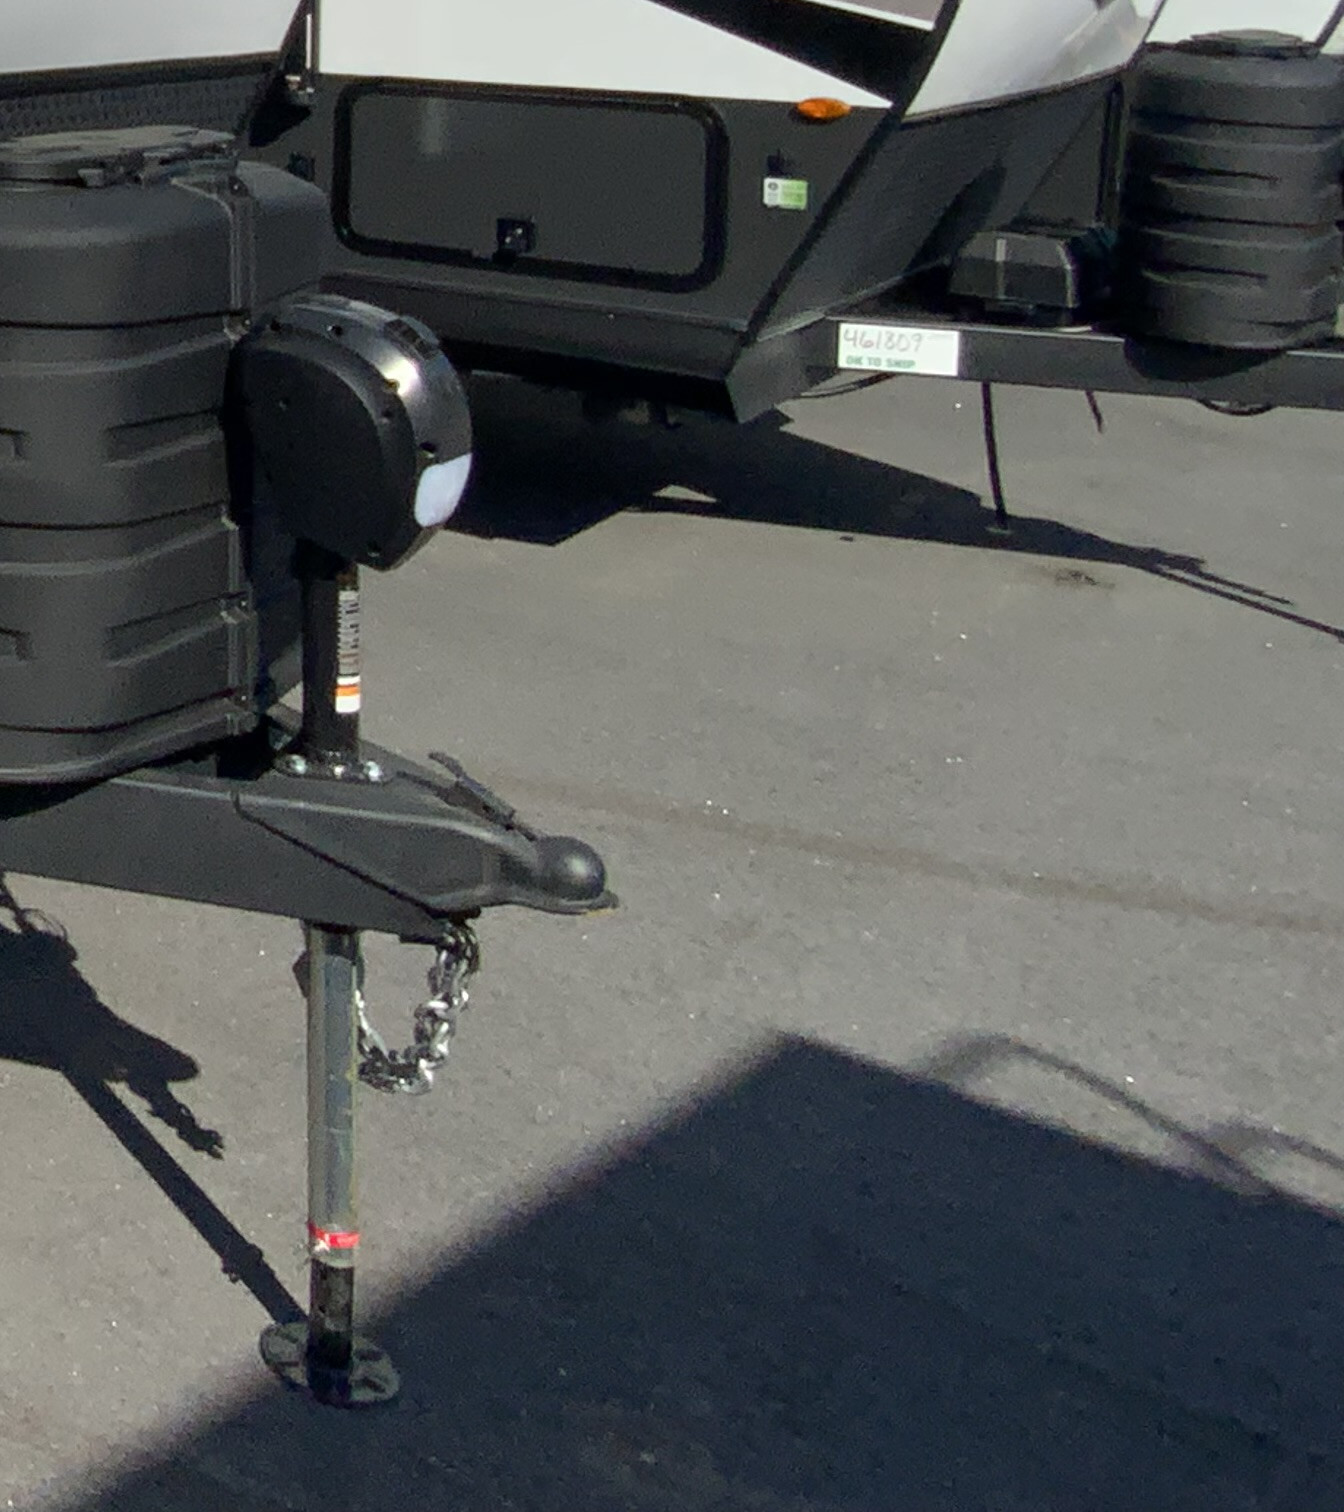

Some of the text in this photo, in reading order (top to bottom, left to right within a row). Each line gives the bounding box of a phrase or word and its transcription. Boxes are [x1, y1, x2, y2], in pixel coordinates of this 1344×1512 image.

[846, 355, 916, 369] OK TO SHIP
